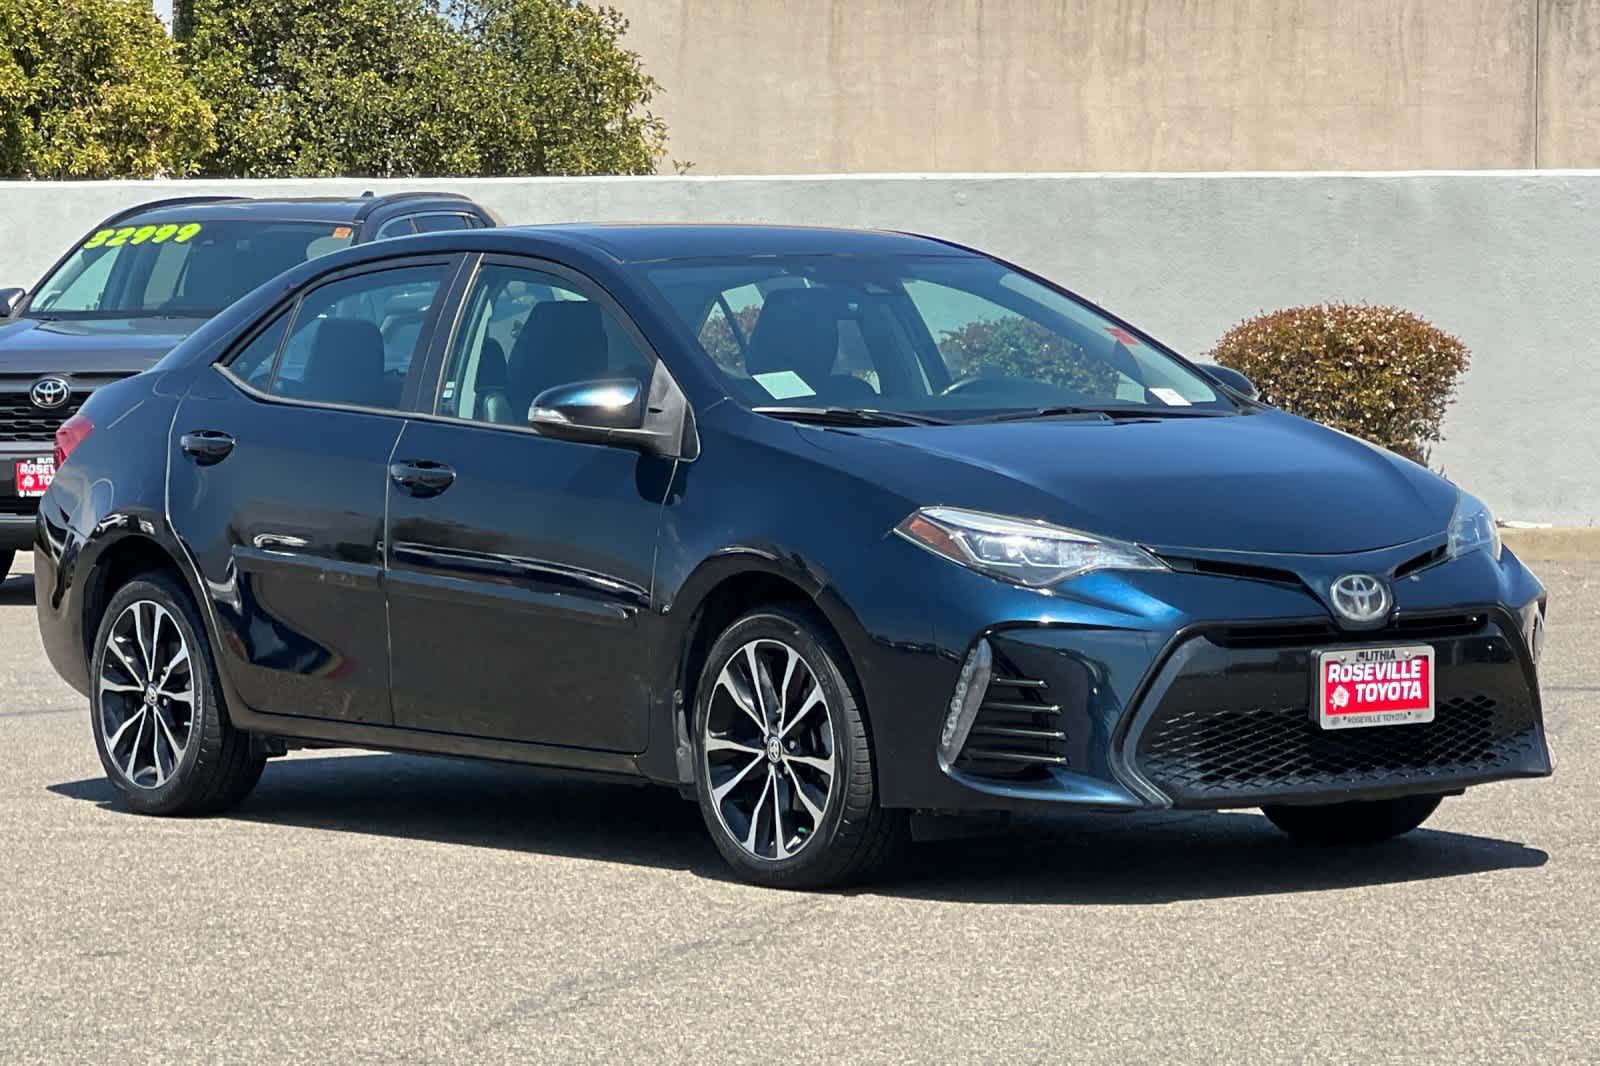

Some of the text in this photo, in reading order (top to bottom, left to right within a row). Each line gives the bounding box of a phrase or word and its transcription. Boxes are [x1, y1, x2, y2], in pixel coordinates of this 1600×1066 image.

[84, 223, 202, 249] 32999
[1365, 649, 1396, 661] LITHIA
[1328, 659, 1422, 683] ROSEVILLE
[1355, 681, 1422, 703] TOYOTA
